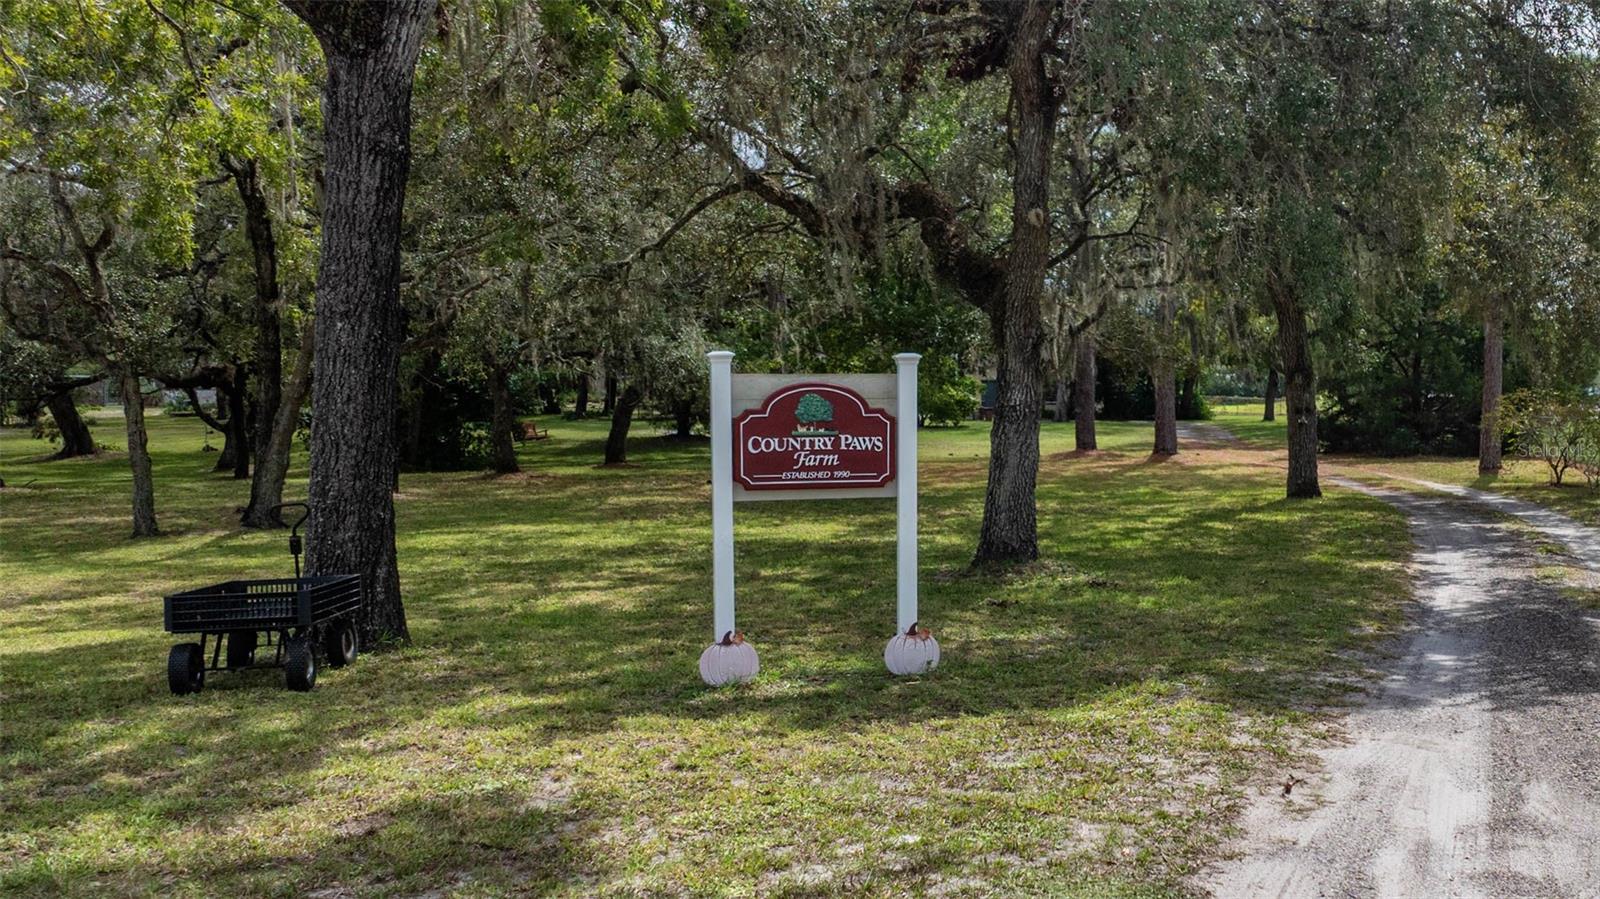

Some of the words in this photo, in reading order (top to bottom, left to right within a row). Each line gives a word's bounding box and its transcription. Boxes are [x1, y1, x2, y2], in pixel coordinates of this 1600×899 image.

[747, 435, 834, 454] COUNTRY
[839, 434, 883, 452] PAWS
[793, 451, 840, 469] Farm
[782, 471, 830, 480] ESTABLISHED
[833, 470, 851, 478] 1990
